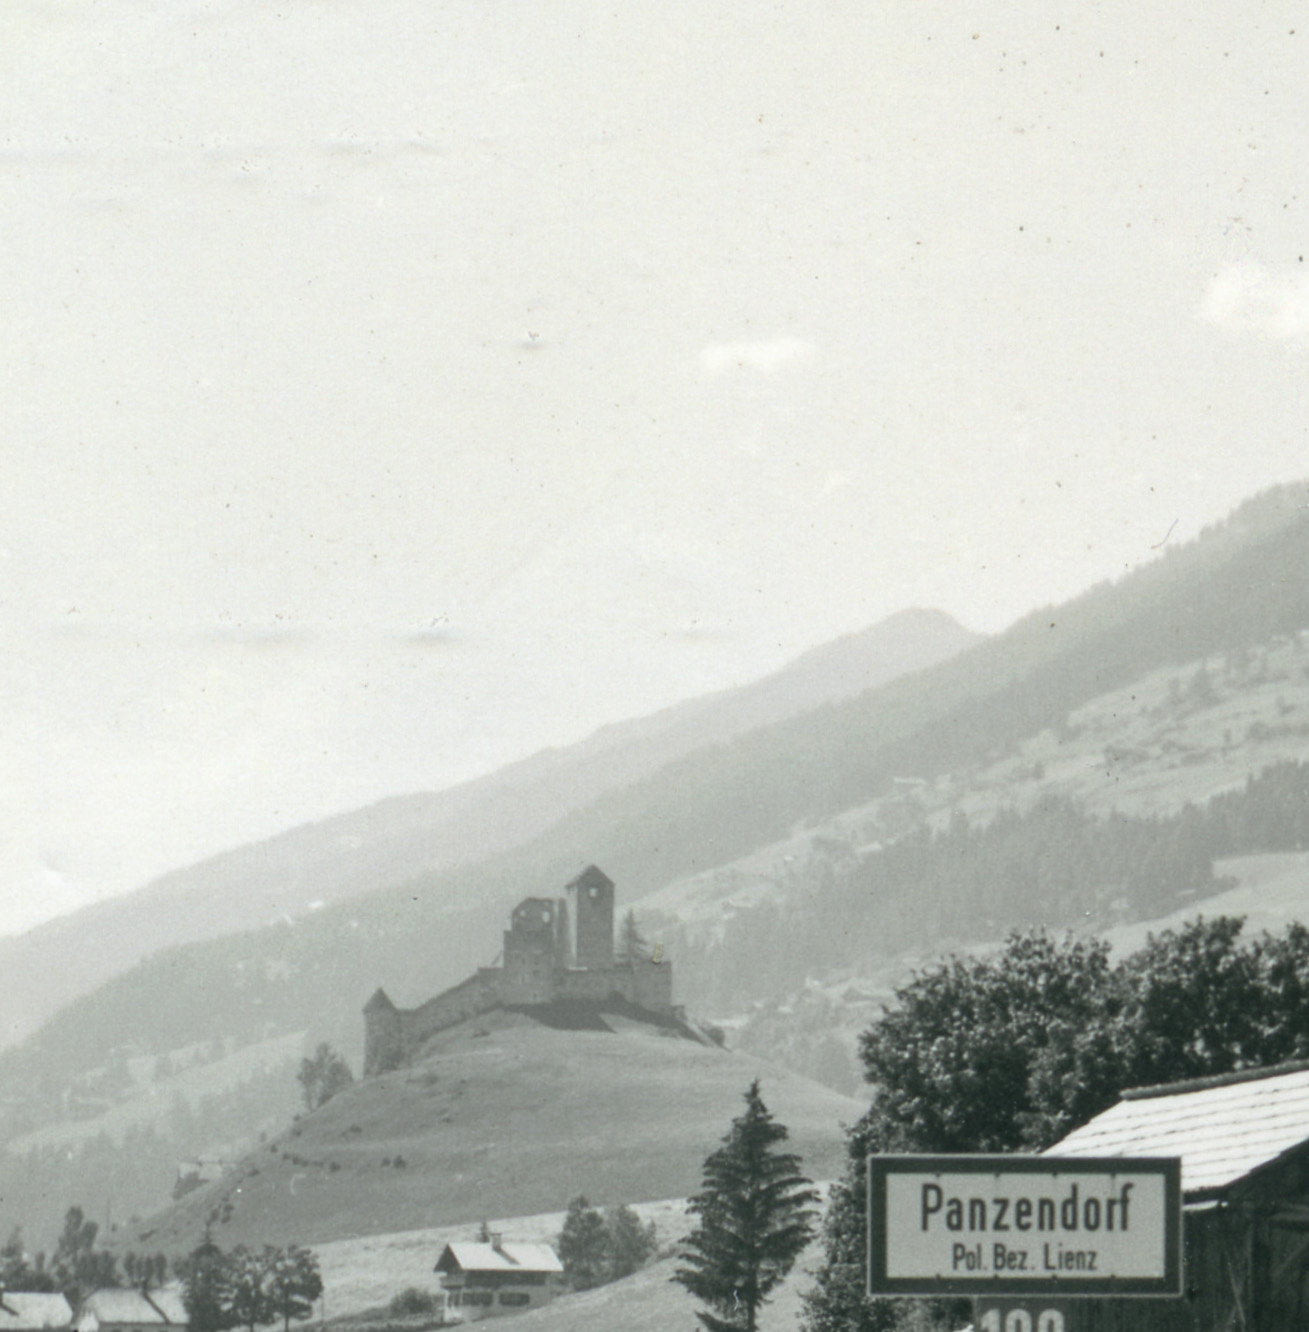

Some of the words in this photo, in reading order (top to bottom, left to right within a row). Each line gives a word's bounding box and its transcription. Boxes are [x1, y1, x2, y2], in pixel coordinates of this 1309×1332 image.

[921, 1183, 1134, 1232] Panzendorf
[953, 1243, 988, 1270] Pol.
[993, 1243, 1035, 1270] Bez.
[1044, 1243, 1098, 1270] Lienz
